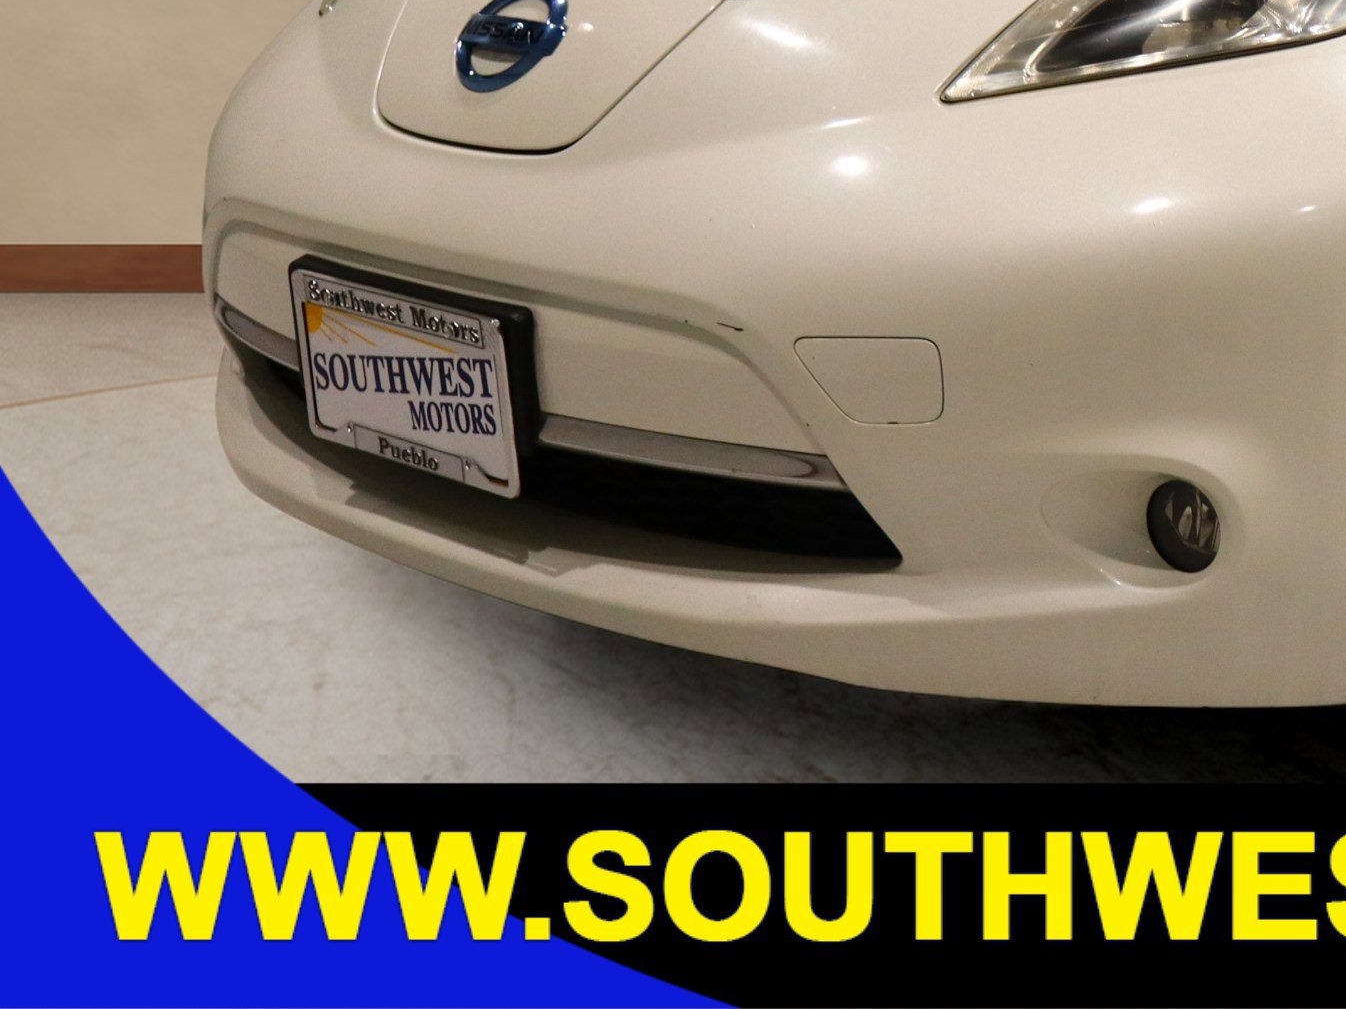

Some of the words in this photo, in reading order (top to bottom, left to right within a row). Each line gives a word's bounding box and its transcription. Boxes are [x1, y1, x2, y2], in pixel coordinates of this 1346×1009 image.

[308, 279, 403, 325] Southwest
[409, 306, 480, 344] Motors
[313, 352, 494, 399] SOUTHWEST
[407, 400, 498, 437] MOTORS
[378, 436, 439, 472] Pueblo
